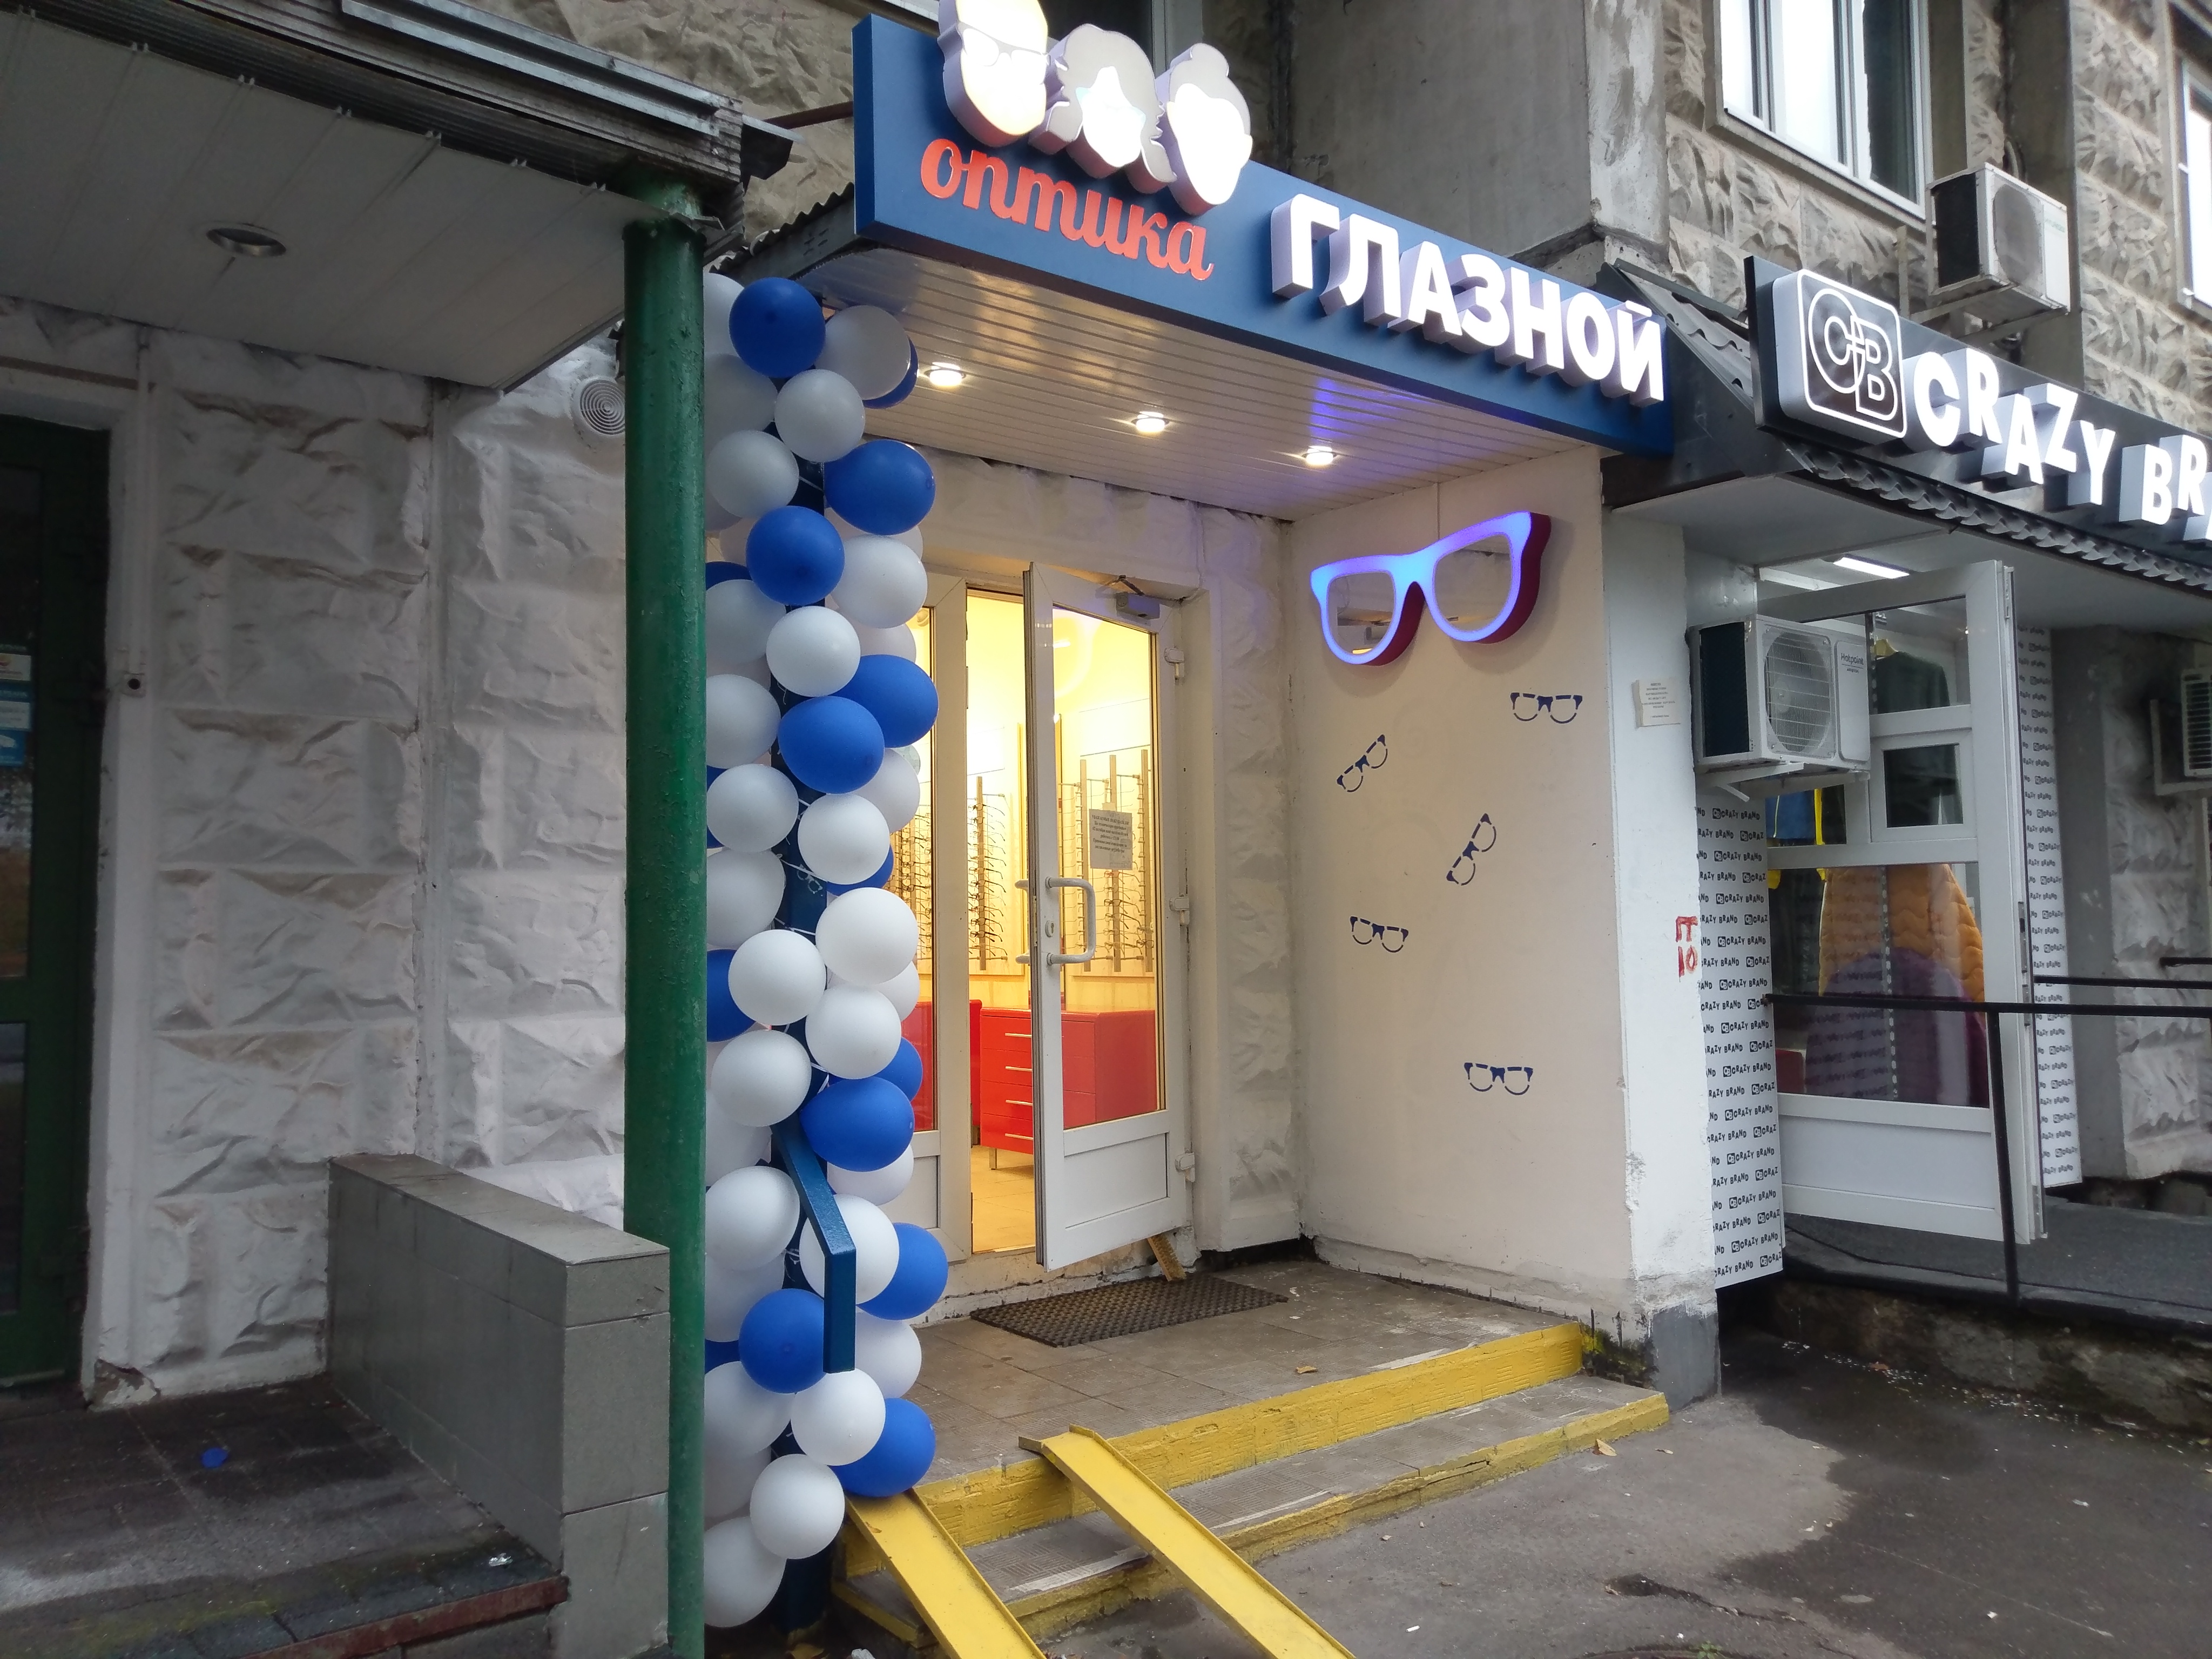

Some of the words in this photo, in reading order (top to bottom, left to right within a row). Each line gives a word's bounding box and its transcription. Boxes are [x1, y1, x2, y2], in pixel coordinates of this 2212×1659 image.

[1288, 193, 1664, 404] ГЛАЗНОЙ
[1913, 347, 2116, 506] CRAZY
[2141, 434, 2212, 541] BR
[1840, 652, 1864, 665] Hotpoint
[1725, 894, 1743, 903] CRAZY
[1746, 894, 1764, 903] BRAND
[1719, 915, 1737, 923] BRAND
[1727, 936, 1745, 946] CRAZY
[1748, 936, 1766, 945] BRAND
[1678, 945, 1698, 977] 10
[1721, 957, 1739, 966] BRAND
[1728, 979, 1746, 988] CRAZY
[1749, 978, 1768, 987] BRAND
[1701, 1001, 1719, 1011] CRAZY
[1723, 1000, 1741, 1009] BRAND
[1730, 1021, 1748, 1030] CRAZY
[1751, 1020, 1769, 1029] BRAND
[1724, 1043, 1743, 1053] BRAND
[1732, 1064, 1750, 1074] CRAZY
[1753, 1062, 1771, 1072] BRAND
[1726, 1086, 1744, 1096] BRAND
[1734, 1108, 1752, 1117] CRAZY
[1755, 1104, 1772, 1115] BRAND
[1707, 1133, 1725, 1143] CRAZY
[1728, 1130, 1746, 1140] BRAND
[1736, 1150, 1754, 1161] CRAZY
[1757, 1147, 1774, 1157] BRAND
[1730, 1173, 1749, 1184] BRAND
[1738, 1194, 1756, 1205] CRAZY
[1759, 1190, 1776, 1201] BRAND
[1732, 1217, 1751, 1228] BRAND
[1741, 1237, 1758, 1249] CRAZY
[1761, 1232, 1778, 1244] BRAND
[1735, 1260, 1753, 1272] BRAND
